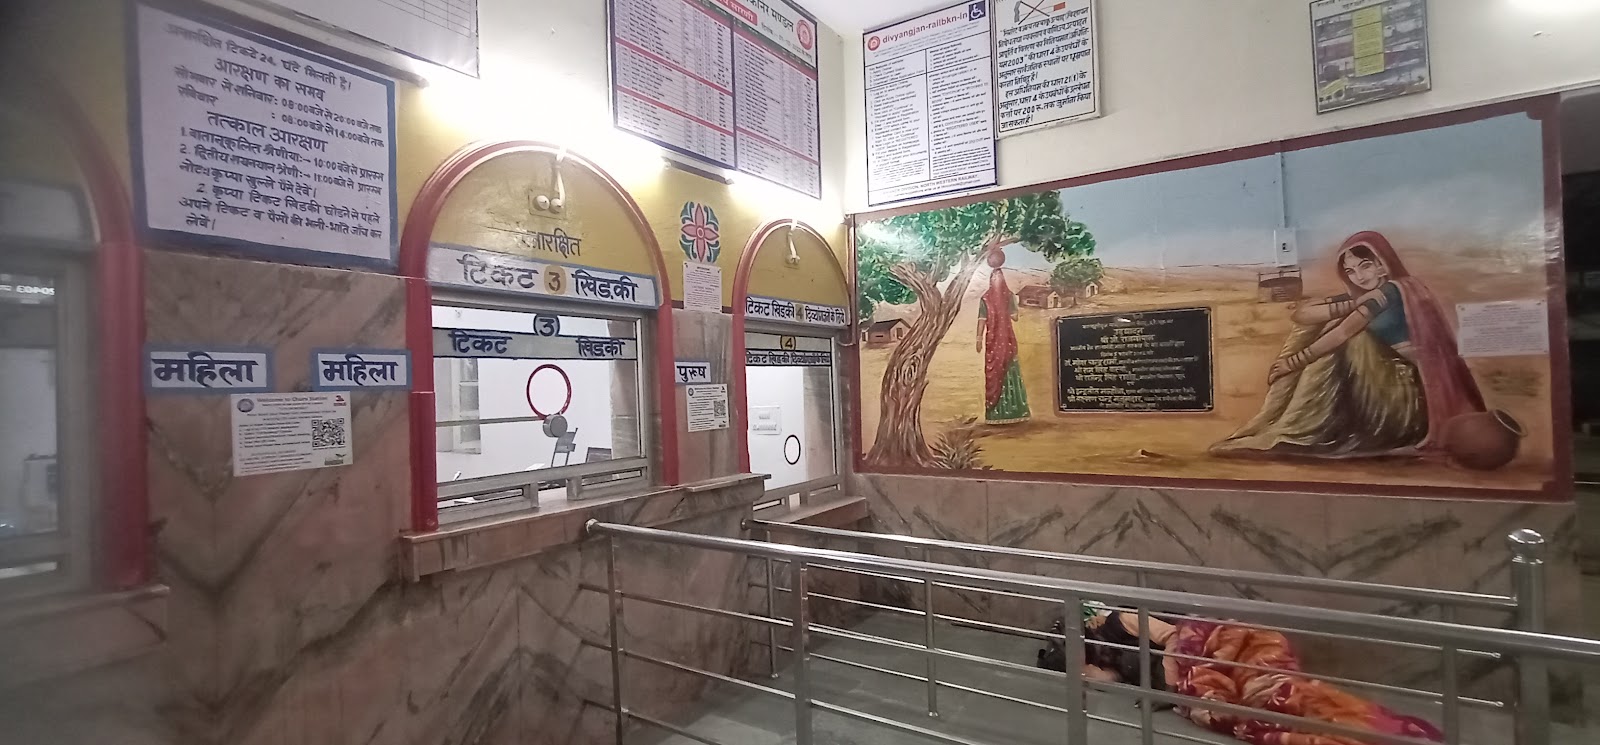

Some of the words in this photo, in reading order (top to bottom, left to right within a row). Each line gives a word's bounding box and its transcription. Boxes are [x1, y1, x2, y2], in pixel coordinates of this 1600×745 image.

[215, 58, 269, 82] आरक्षण
[274, 76, 291, 91] का
[295, 82, 325, 101] समय
[221, 78, 233, 92] से
[1023, 107, 1035, 115] 200
[207, 111, 267, 138] तत्काल
[269, 127, 329, 152] आरक्षण
[194, 144, 229, 160] द्वितीय
[179, 197, 212, 211] अपने
[216, 200, 250, 216] टिकट
[254, 210, 264, 220] व
[290, 213, 303, 226] की
[370, 229, 382, 239] कर
[248, 190, 282, 206] टिकट
[360, 212, 380, 225] पहले
[456, 253, 538, 289] टिकट
[572, 269, 639, 302] खिड़की
[449, 331, 512, 353] टिकट
[785, 337, 793, 348] 4
[152, 352, 258, 388] महिला
[321, 354, 399, 386] महिला
